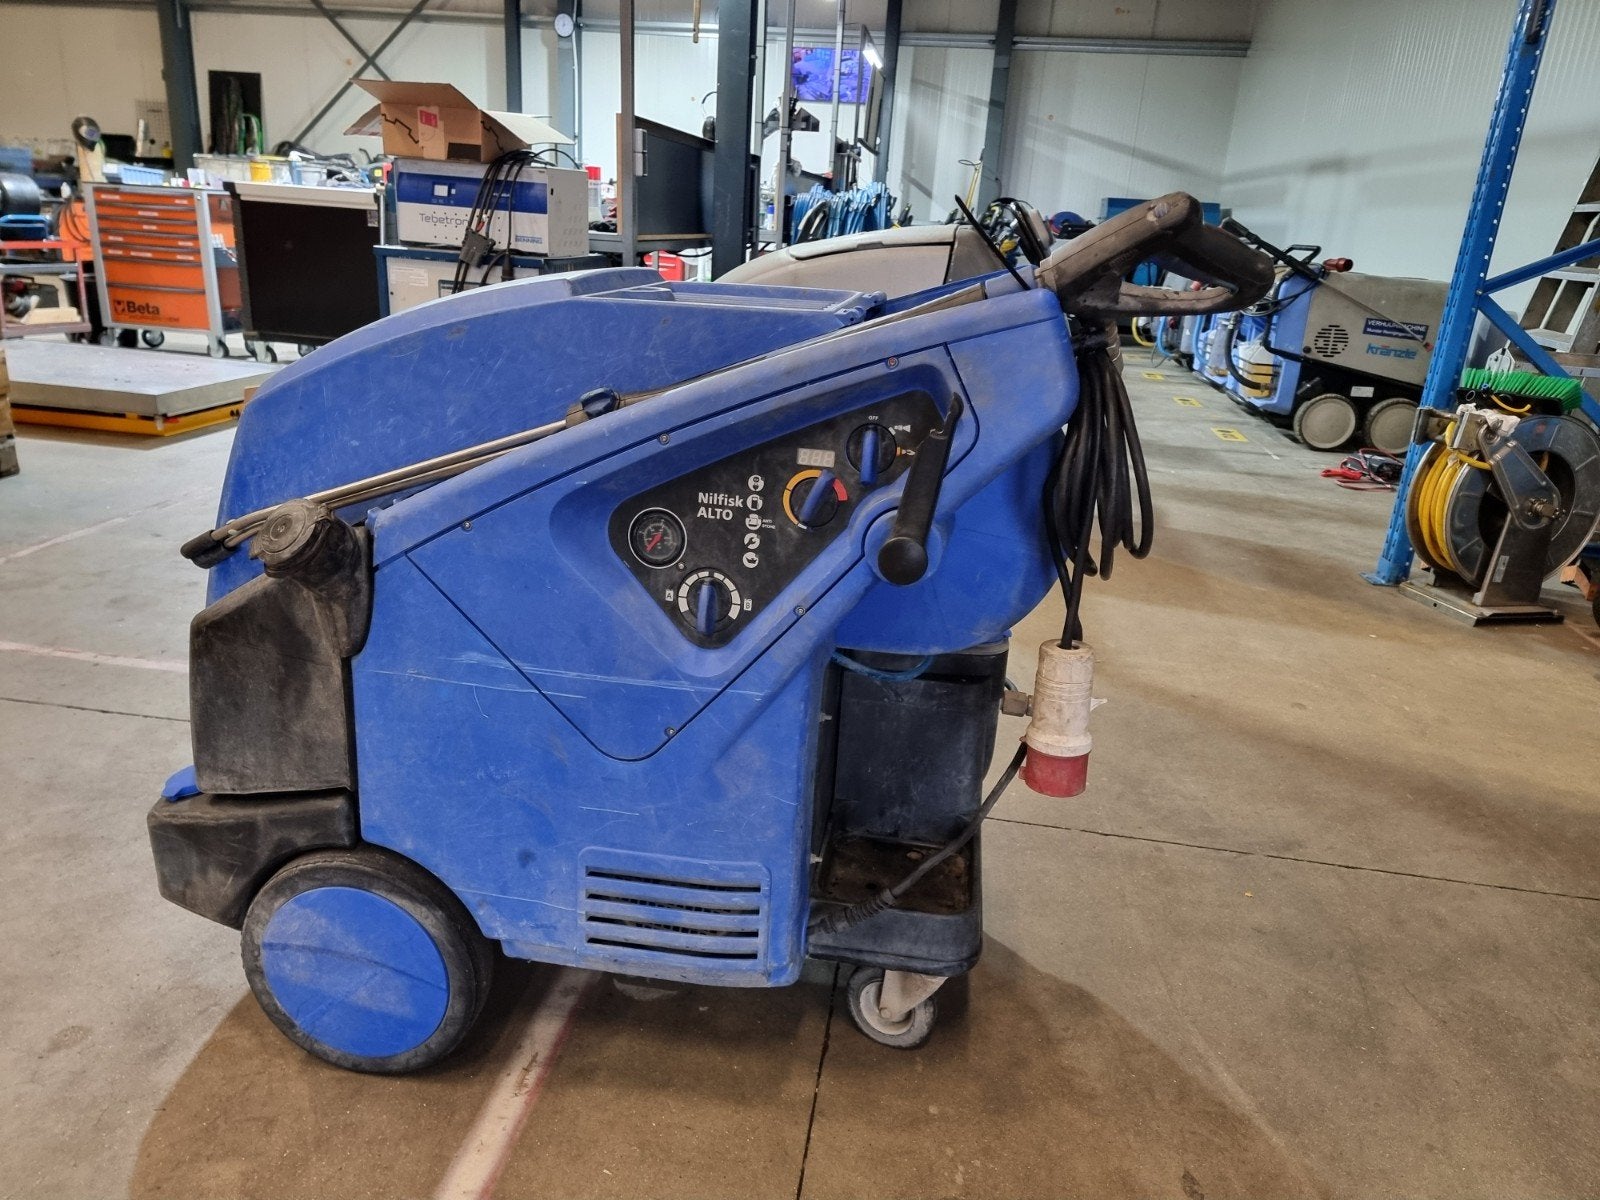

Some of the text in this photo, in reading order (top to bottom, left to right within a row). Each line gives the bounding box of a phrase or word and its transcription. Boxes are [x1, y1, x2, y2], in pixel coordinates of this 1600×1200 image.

[126, 301, 160, 315] Beta
[698, 492, 744, 508] Nilfisk
[697, 506, 733, 521] ALTO
